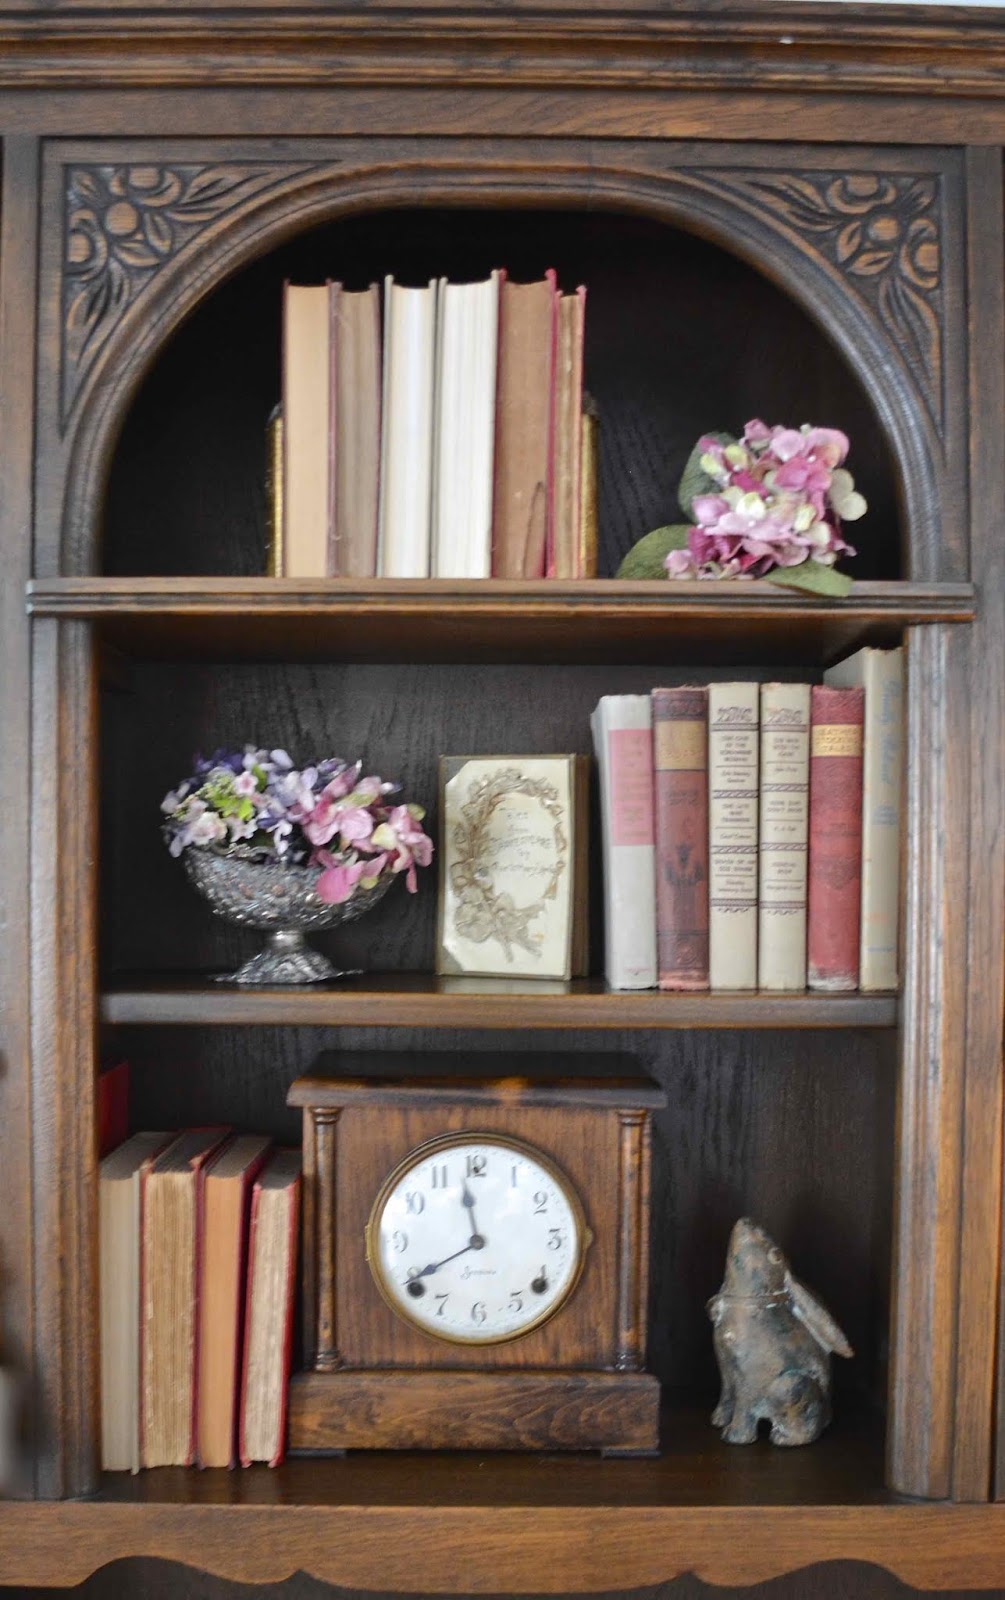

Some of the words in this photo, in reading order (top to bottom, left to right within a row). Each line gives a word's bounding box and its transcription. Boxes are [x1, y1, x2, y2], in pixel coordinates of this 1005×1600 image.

[431, 1165, 448, 1189] 11
[464, 1155, 487, 1178] 12
[511, 1166, 518, 1188] 1
[533, 1190, 548, 1216] 2
[547, 1228, 562, 1250] 3
[434, 1293, 450, 1316] 7
[508, 1290, 524, 1313] 5
[471, 1302, 487, 1327] 6
